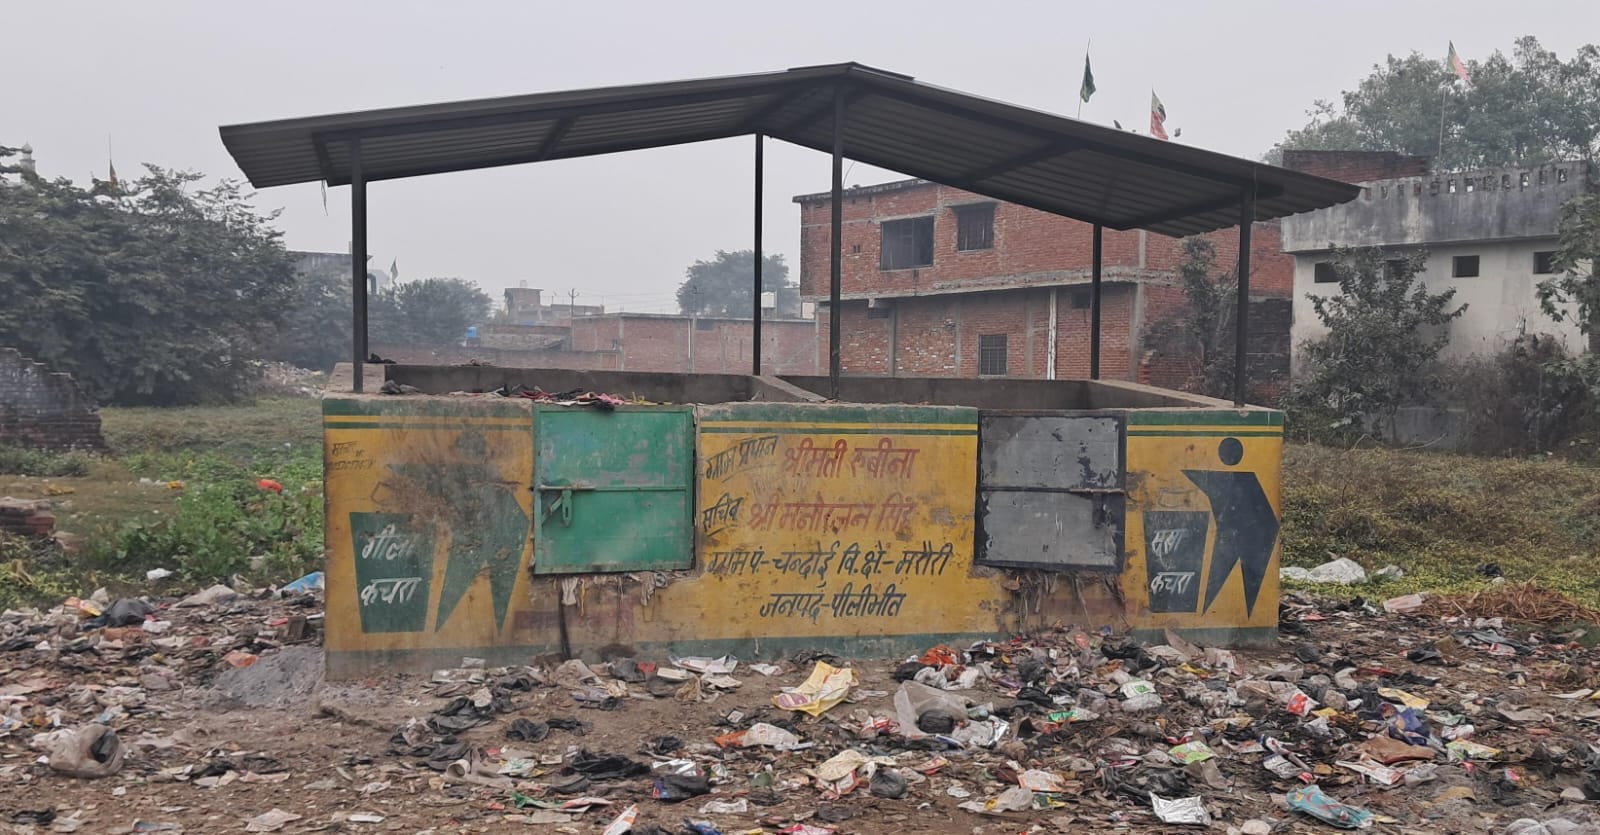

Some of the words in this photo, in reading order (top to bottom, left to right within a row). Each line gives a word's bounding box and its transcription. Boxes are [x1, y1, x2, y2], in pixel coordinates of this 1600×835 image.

[784, 437, 848, 478] श्रीमती
[703, 493, 744, 532] सचिव
[361, 576, 422, 607] कचरा
[1151, 571, 1195, 595] कचरा
